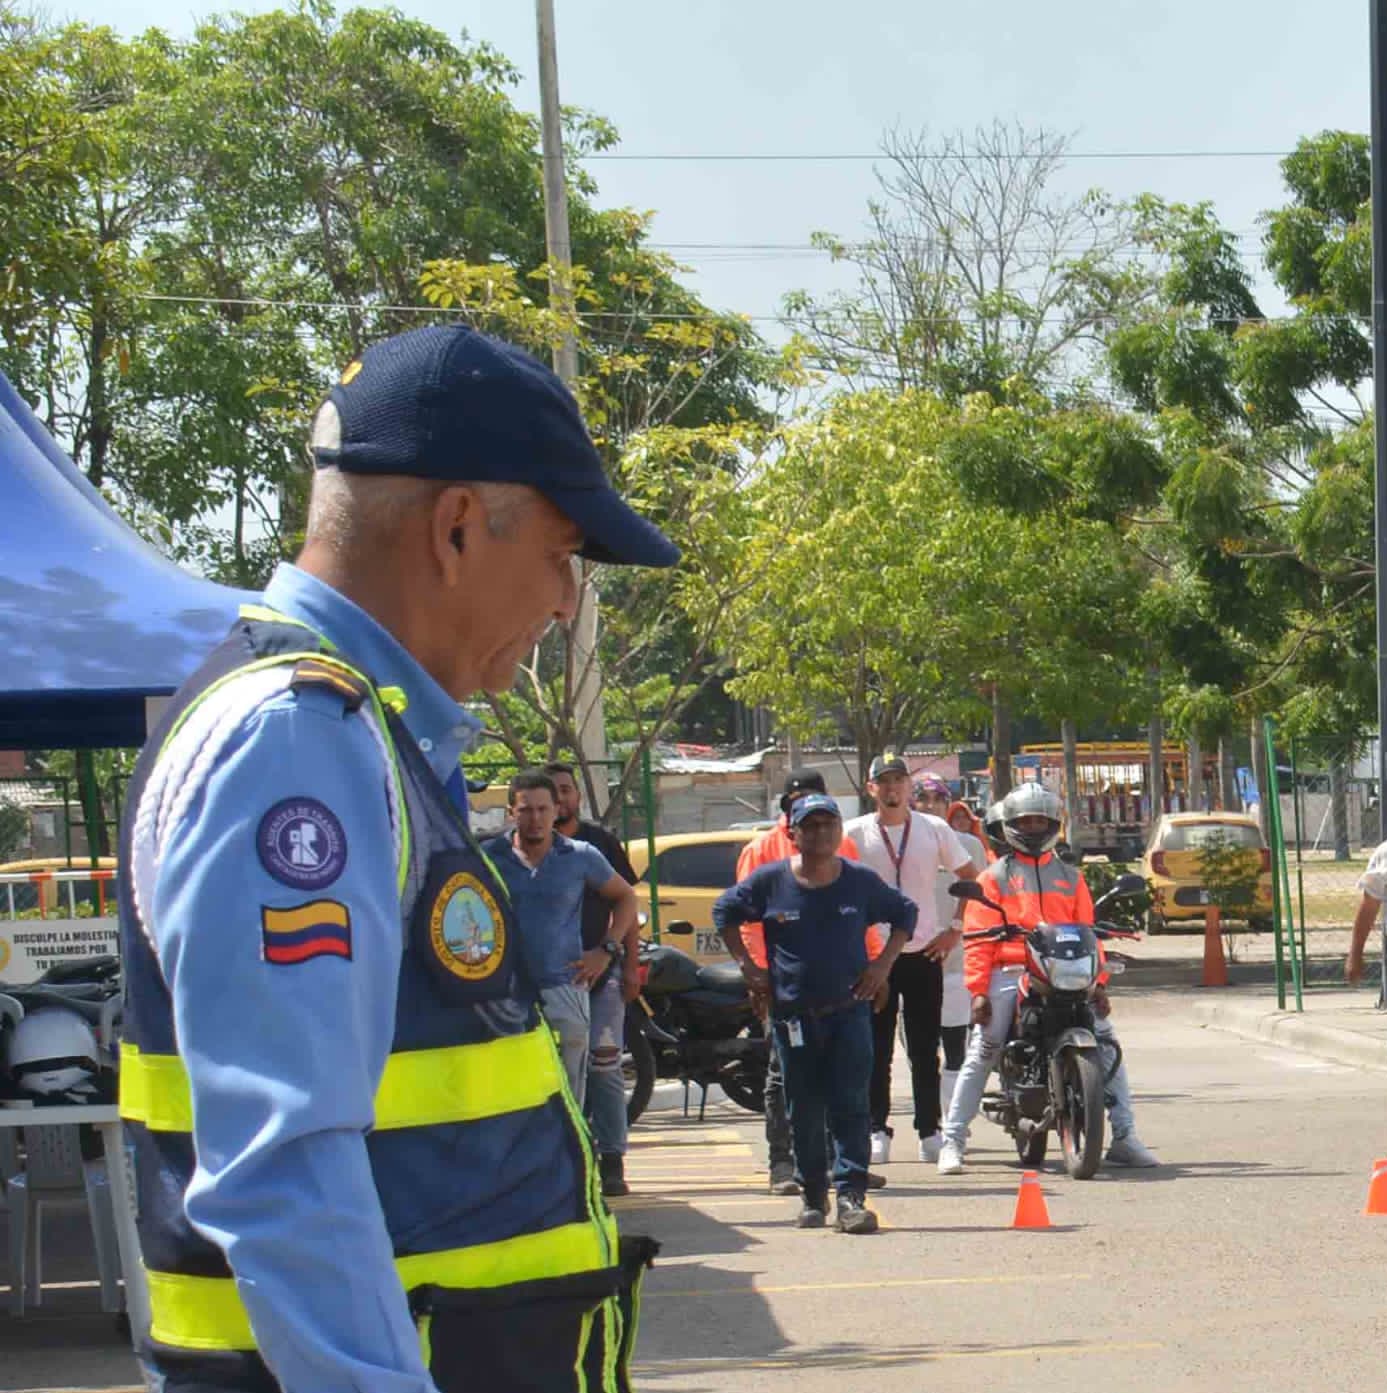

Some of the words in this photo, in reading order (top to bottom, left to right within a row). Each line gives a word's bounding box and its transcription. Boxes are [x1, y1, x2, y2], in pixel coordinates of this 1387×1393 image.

[13, 932, 57, 944] DISCULPE
[60, 931, 72, 942] LA
[25, 946, 87, 957] TRABAJAMOS
[89, 944, 108, 955] POR
